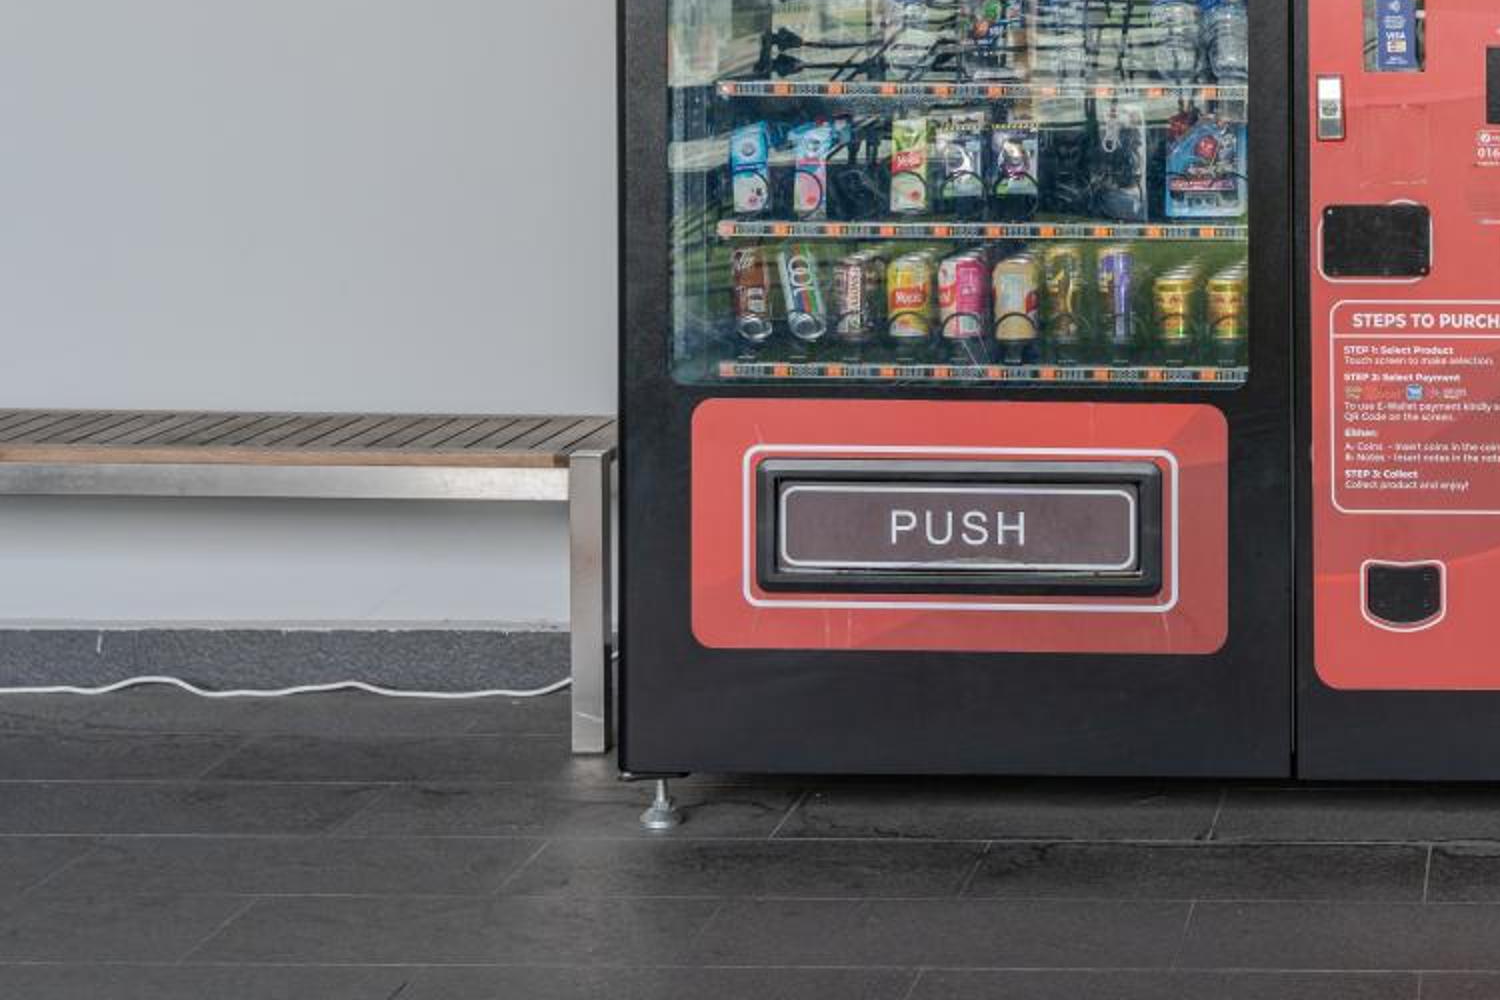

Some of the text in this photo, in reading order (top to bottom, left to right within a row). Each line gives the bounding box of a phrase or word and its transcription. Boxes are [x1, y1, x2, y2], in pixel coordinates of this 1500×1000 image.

[1352, 313, 1407, 329] STEPS
[1412, 313, 1435, 329] TO
[1344, 345, 1454, 355] STEP 1: Select Product
[1344, 356, 1373, 365] Touch
[1375, 357, 1406, 365] screen
[1408, 357, 1418, 365] to
[1420, 357, 1447, 365] make
[1344, 372, 1369, 382] STEP
[1381, 372, 1413, 382] Select
[1415, 373, 1460, 384] Payment
[1344, 401, 1356, 411] To
[1419, 403, 1460, 413] payment
[1344, 412, 1359, 422] QR
[1361, 412, 1386, 421] Code
[1403, 412, 1419, 421] the
[1357, 442, 1383, 451] Coins
[1423, 443, 1449, 452] coins
[1461, 443, 1478, 452] the
[1356, 453, 1385, 462] Notes
[1393, 453, 1421, 463] Insert
[1423, 453, 1450, 463] notes
[1451, 453, 1460, 463] in
[1463, 453, 1479, 463] the
[1344, 469, 1370, 479] STEP
[1383, 469, 1418, 479] Collect
[1344, 480, 1378, 489] Collect
[1380, 480, 1417, 491] product
[1419, 481, 1438, 490] and
[890, 510, 1027, 546] PUSH
